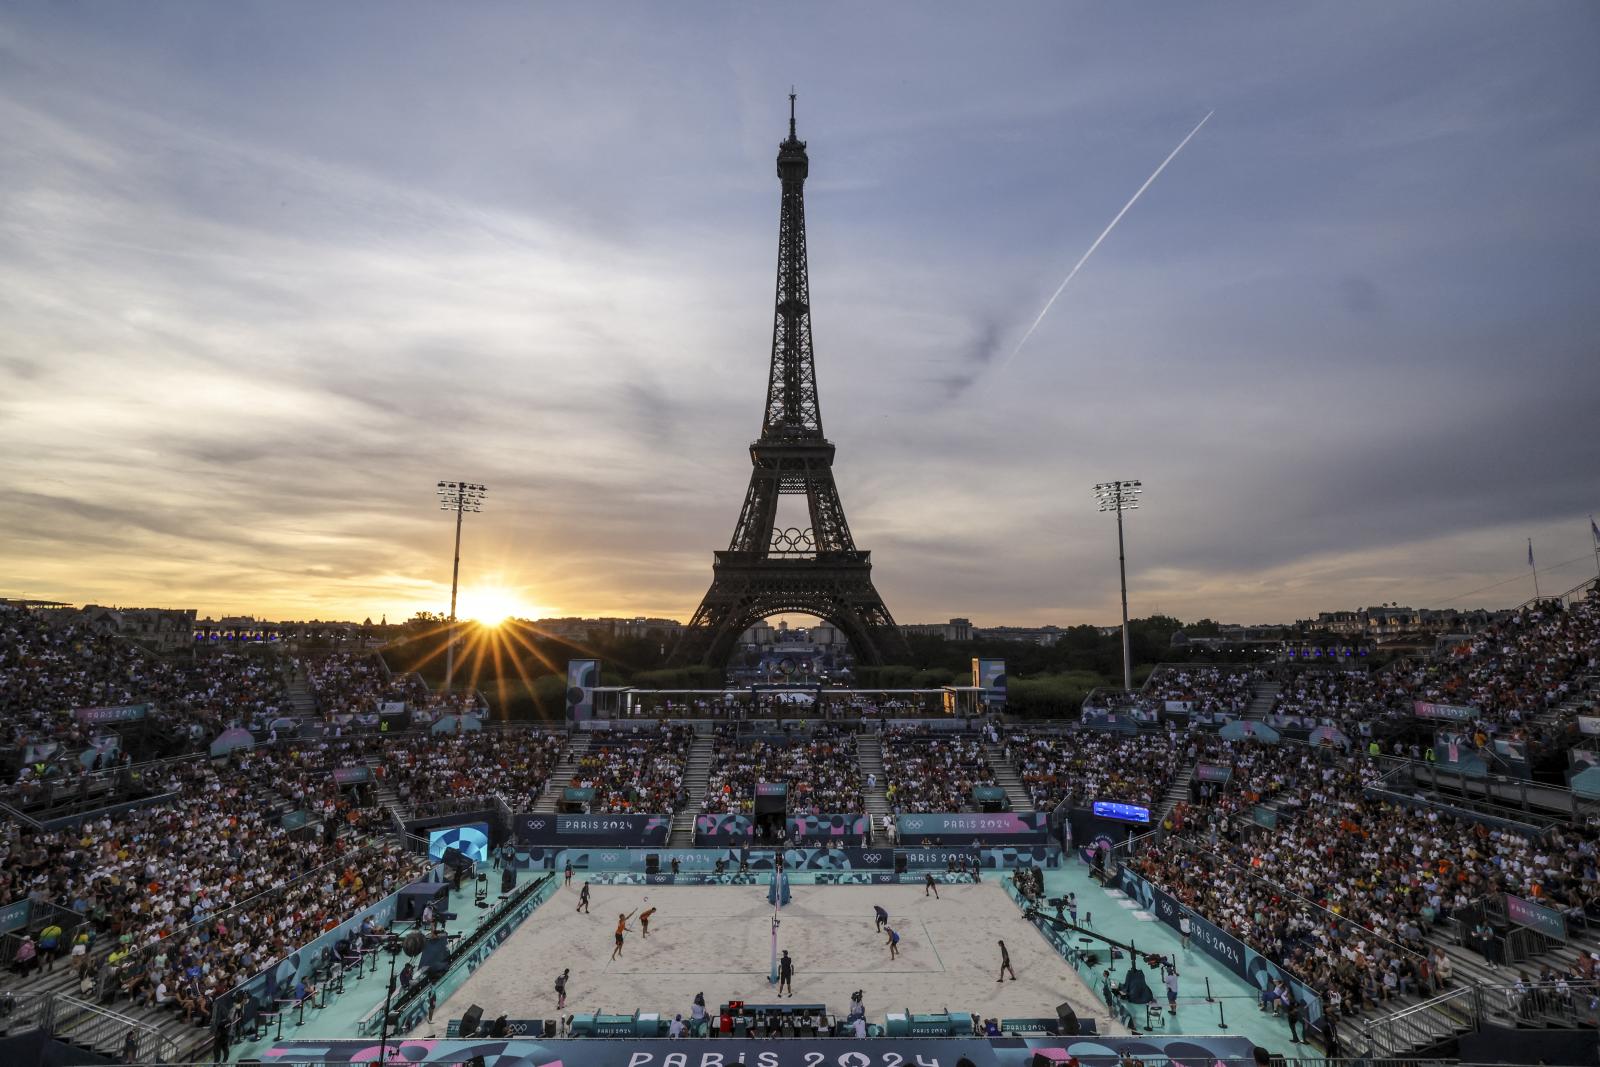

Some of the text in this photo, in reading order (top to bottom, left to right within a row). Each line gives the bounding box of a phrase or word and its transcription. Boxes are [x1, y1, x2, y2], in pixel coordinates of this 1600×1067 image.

[603, 821, 632, 829] 2024
[981, 820, 1010, 828] 2024
[906, 854, 936, 862] ARIS
[1191, 922, 1239, 964] ARIS 2024
